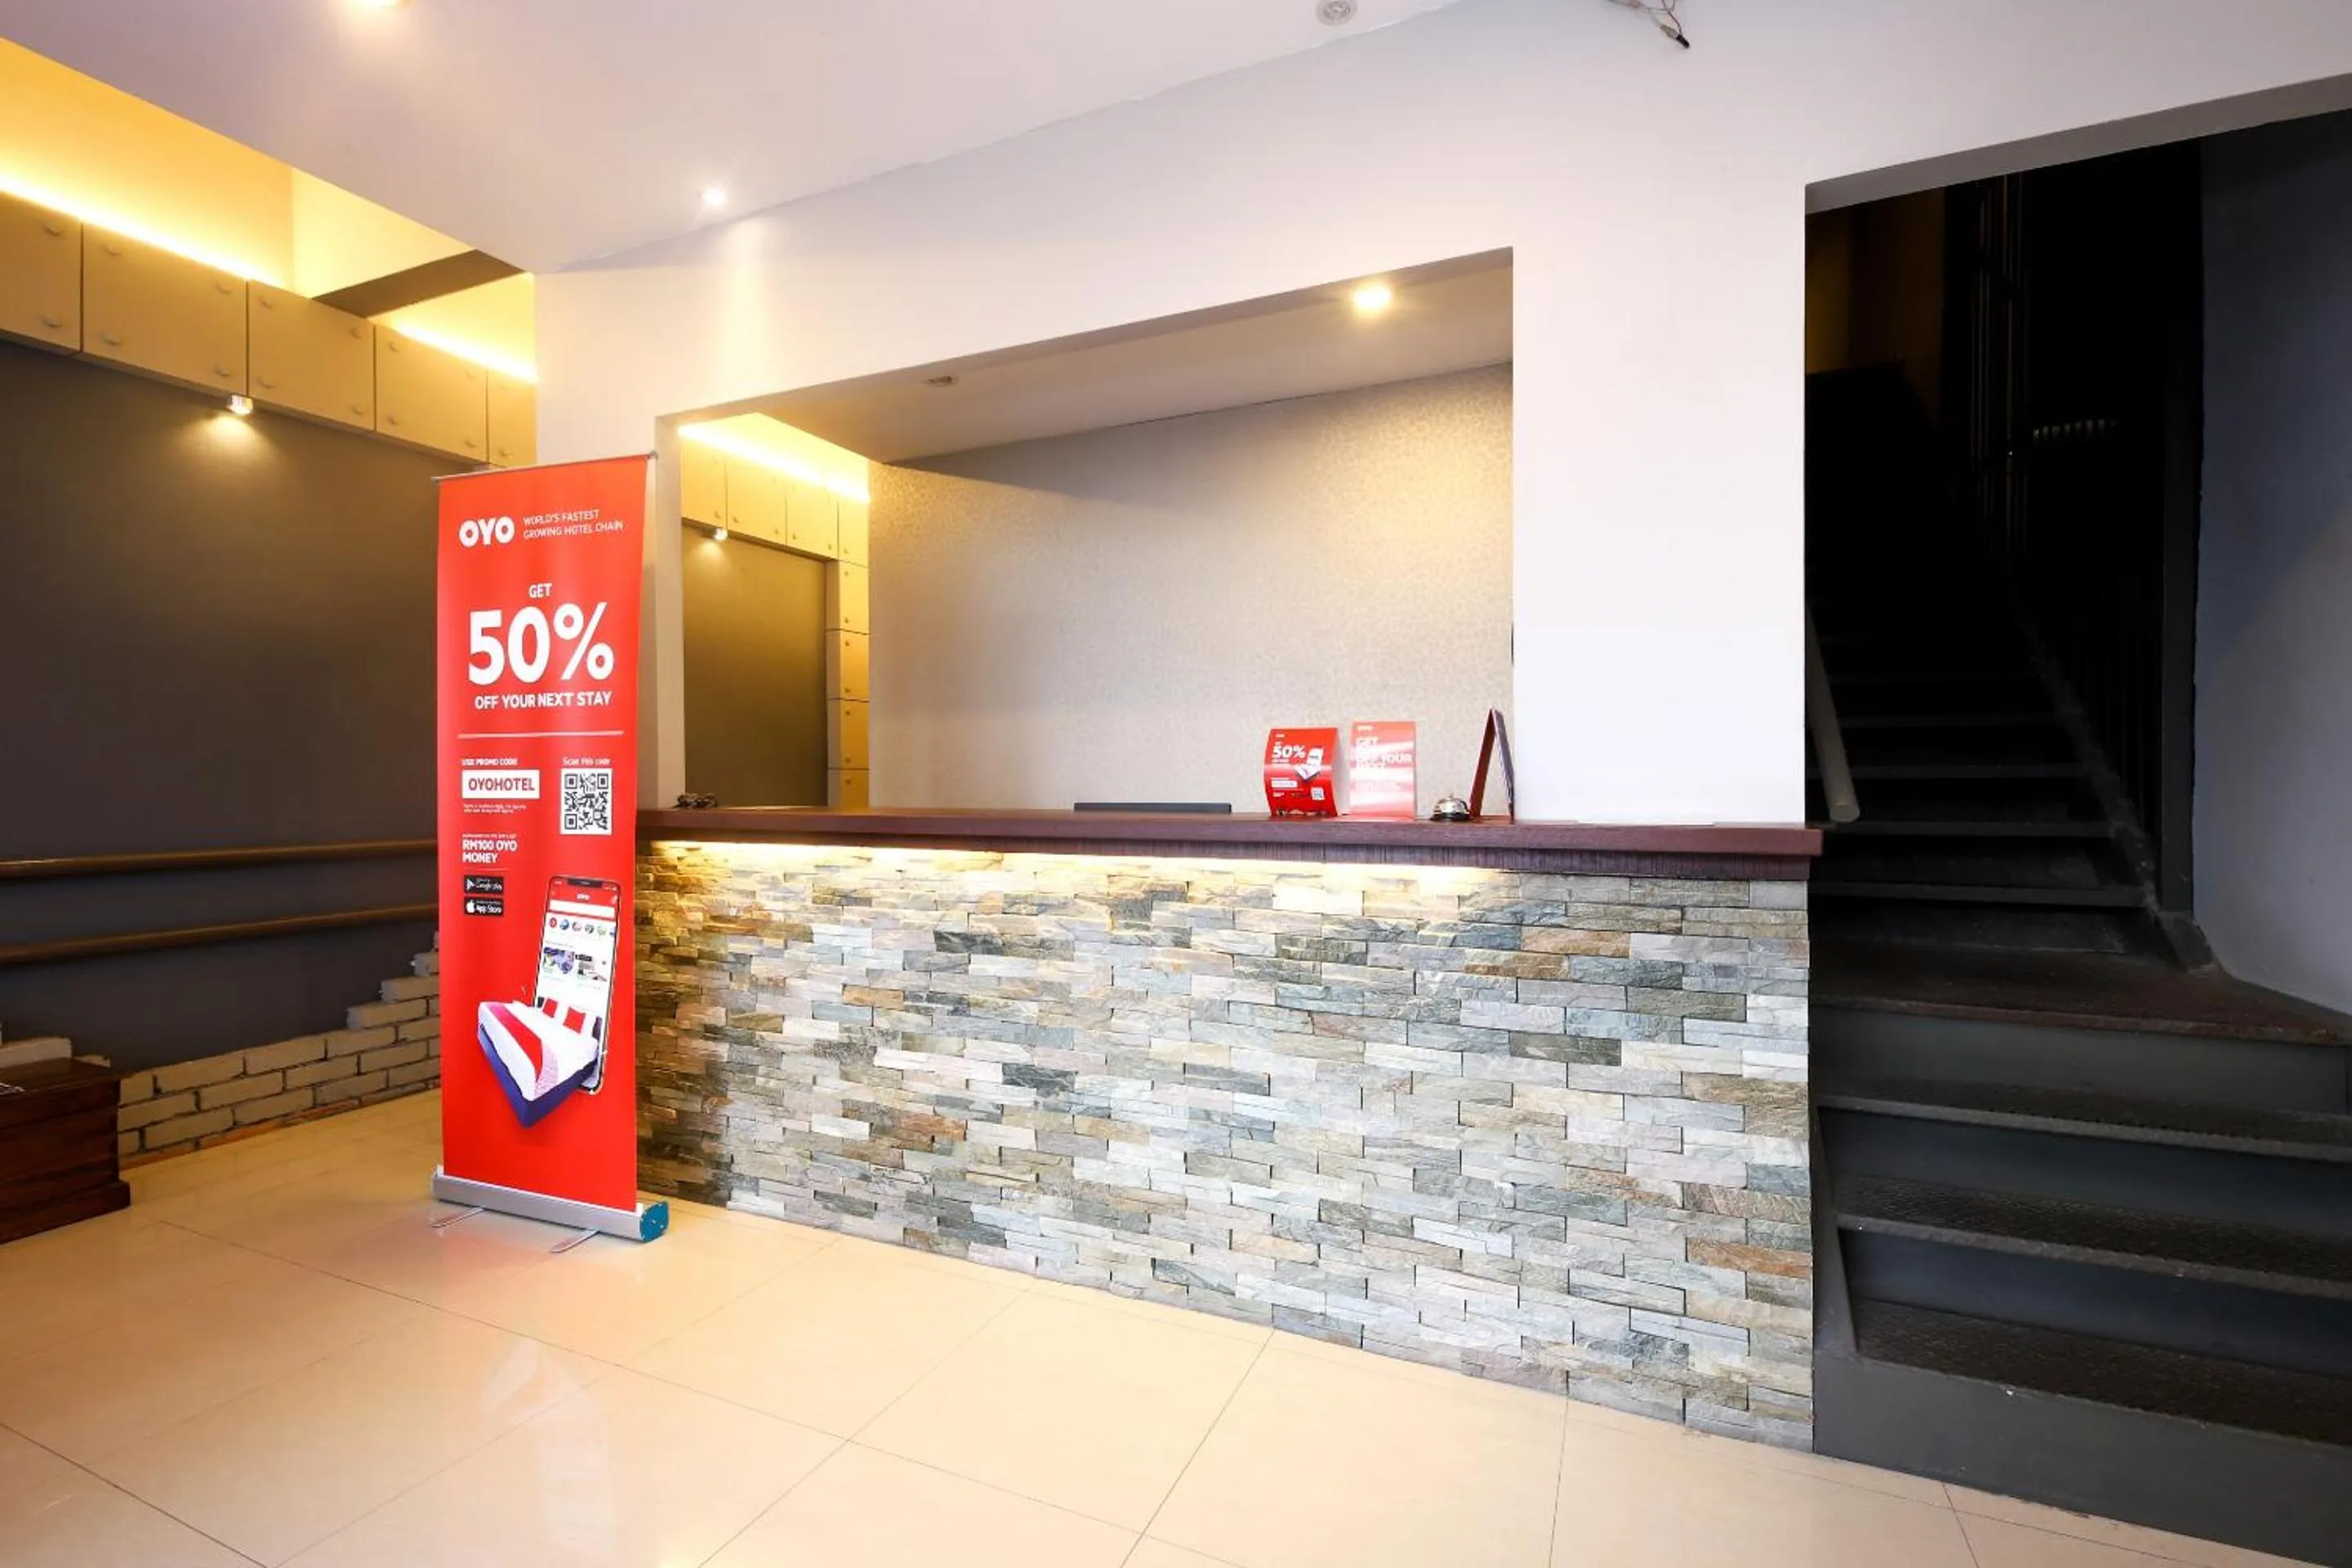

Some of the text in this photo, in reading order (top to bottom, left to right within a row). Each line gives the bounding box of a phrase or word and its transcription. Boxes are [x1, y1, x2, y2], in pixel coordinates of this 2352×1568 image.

[562, 509, 599, 522] FASTEST
[459, 516, 514, 547] OYO
[523, 519, 624, 540] GROWING HOTEL CHAIN
[528, 583, 552, 599] GET
[468, 602, 614, 685] 50%
[474, 691, 612, 710] OFF YOUR NEXT STAY
[1272, 744, 1306, 759] 50%
[468, 777, 536, 791] OYOHOTEL
[462, 839, 518, 852] RM100 OYO
[462, 852, 498, 863] MONEY
